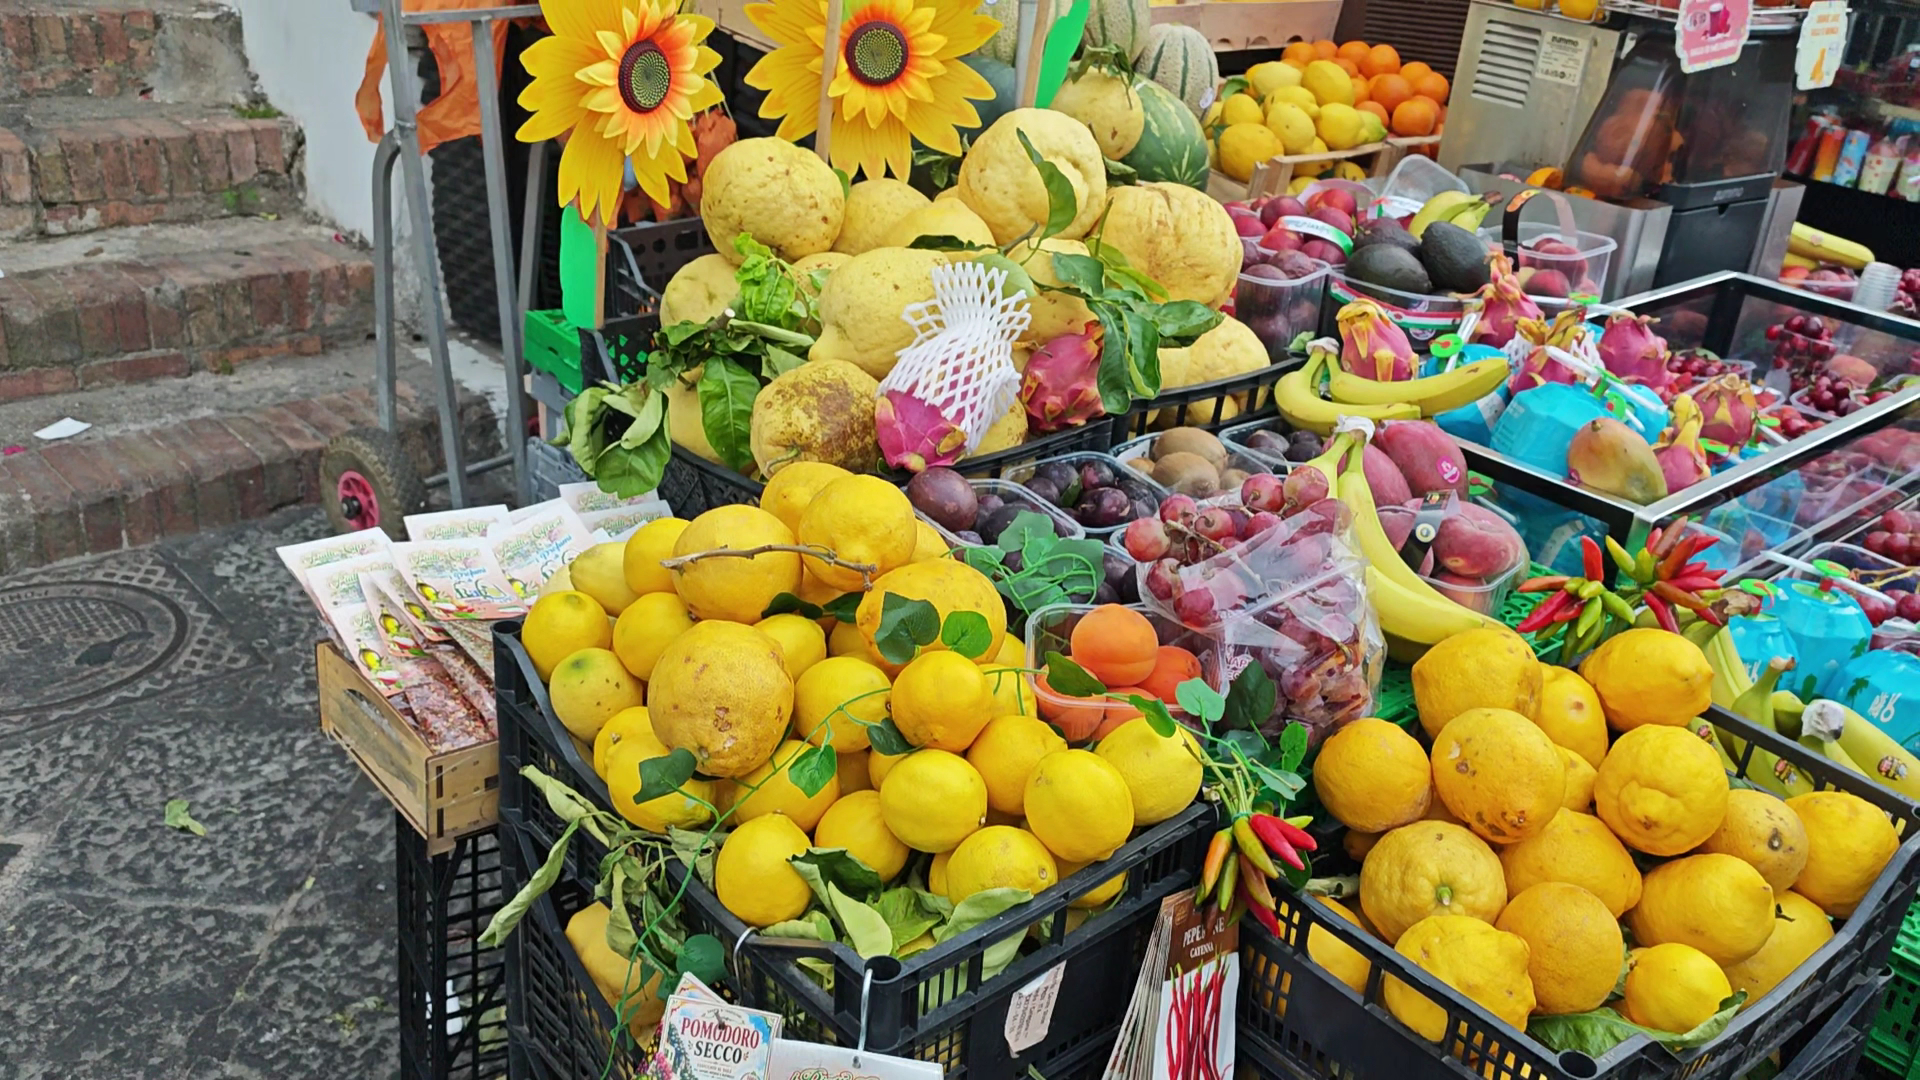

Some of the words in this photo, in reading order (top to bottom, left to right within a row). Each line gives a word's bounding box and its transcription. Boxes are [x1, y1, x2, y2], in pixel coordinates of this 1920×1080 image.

[1183, 917, 1225, 948] PEPENE
[681, 1017, 760, 1049] POMODORO
[694, 1040, 742, 1064] SECCO
